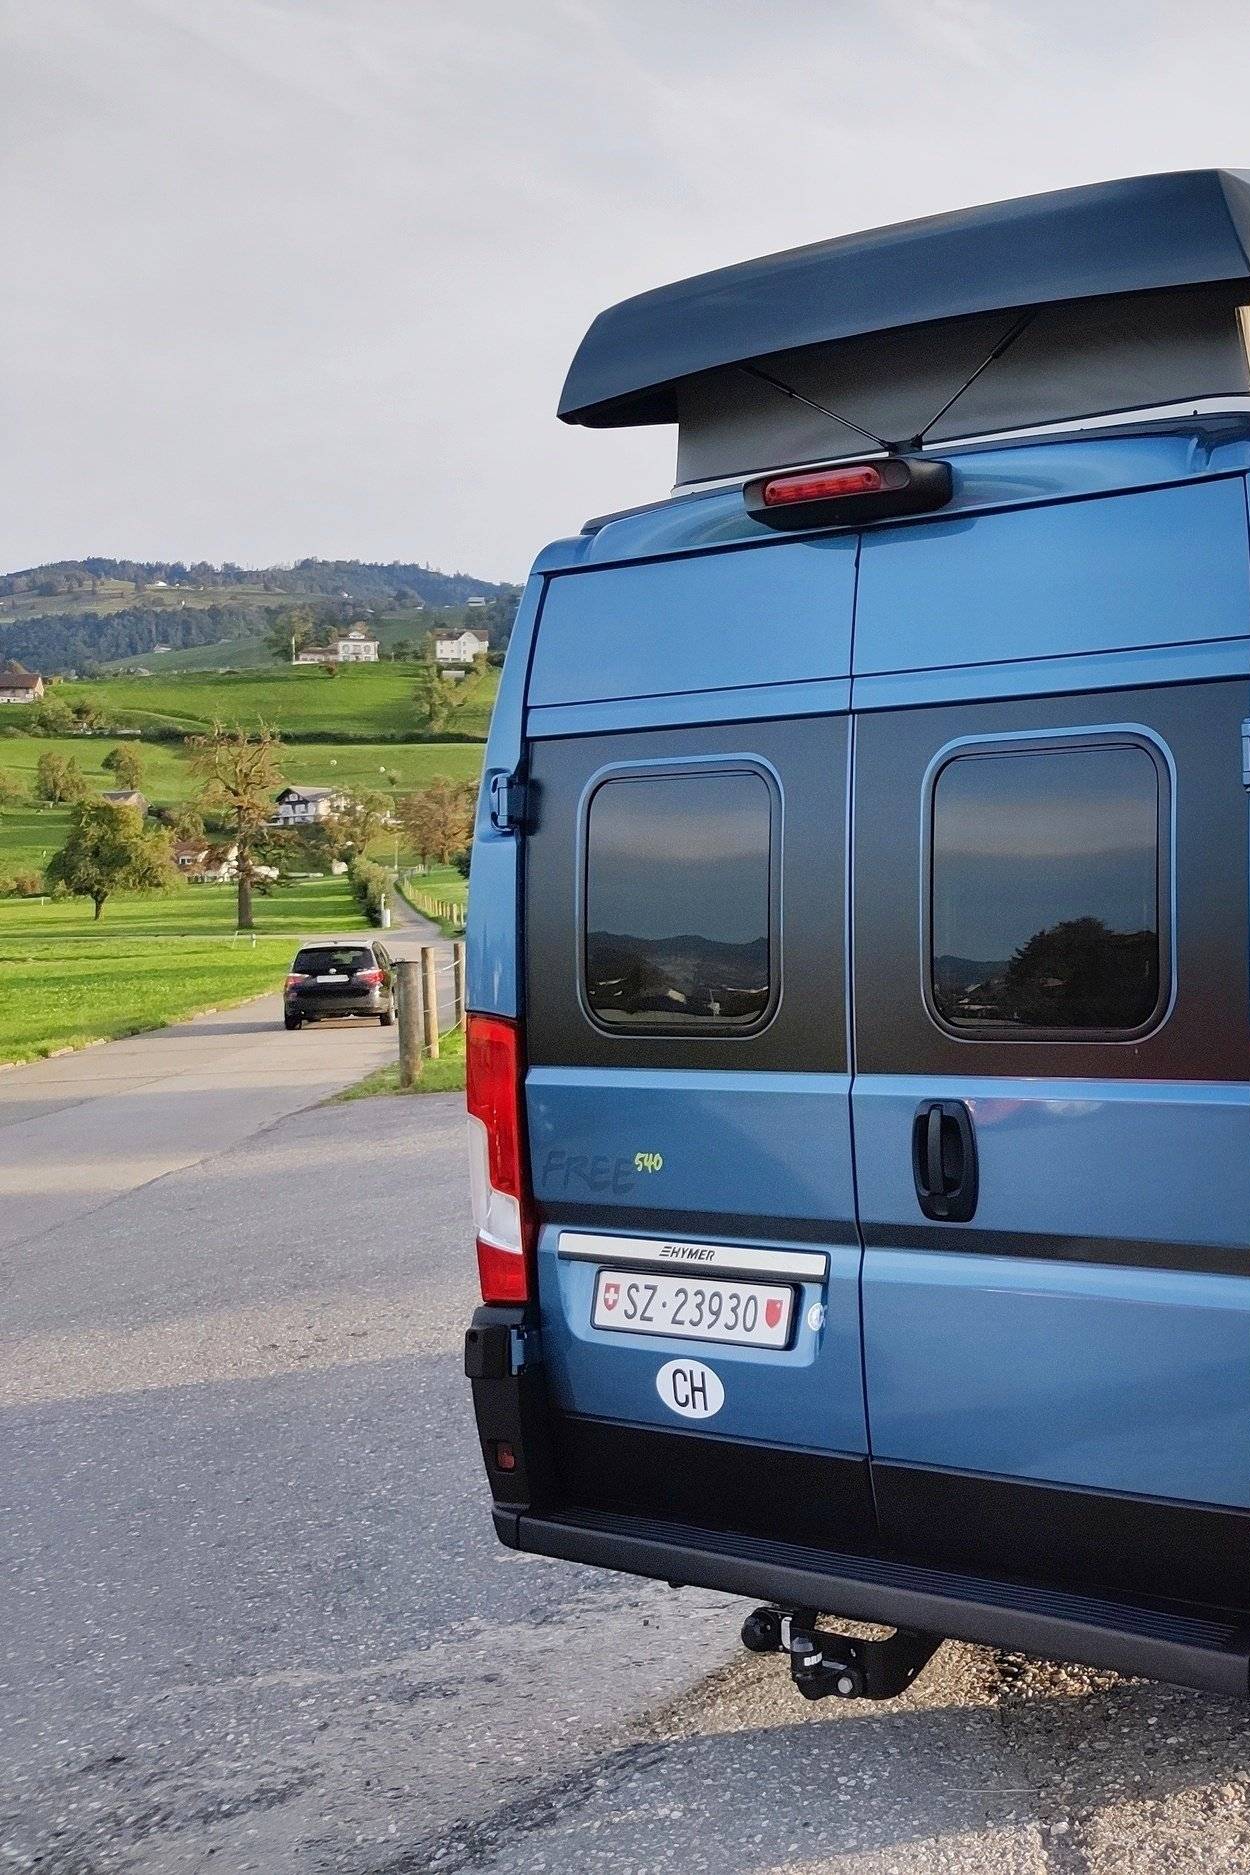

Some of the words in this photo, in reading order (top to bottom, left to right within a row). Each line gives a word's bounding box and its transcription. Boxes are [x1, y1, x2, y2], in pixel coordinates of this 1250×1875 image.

[541, 1151, 634, 1195] FREE
[634, 1152, 663, 1173] 540
[672, 1368, 708, 1411] CH
